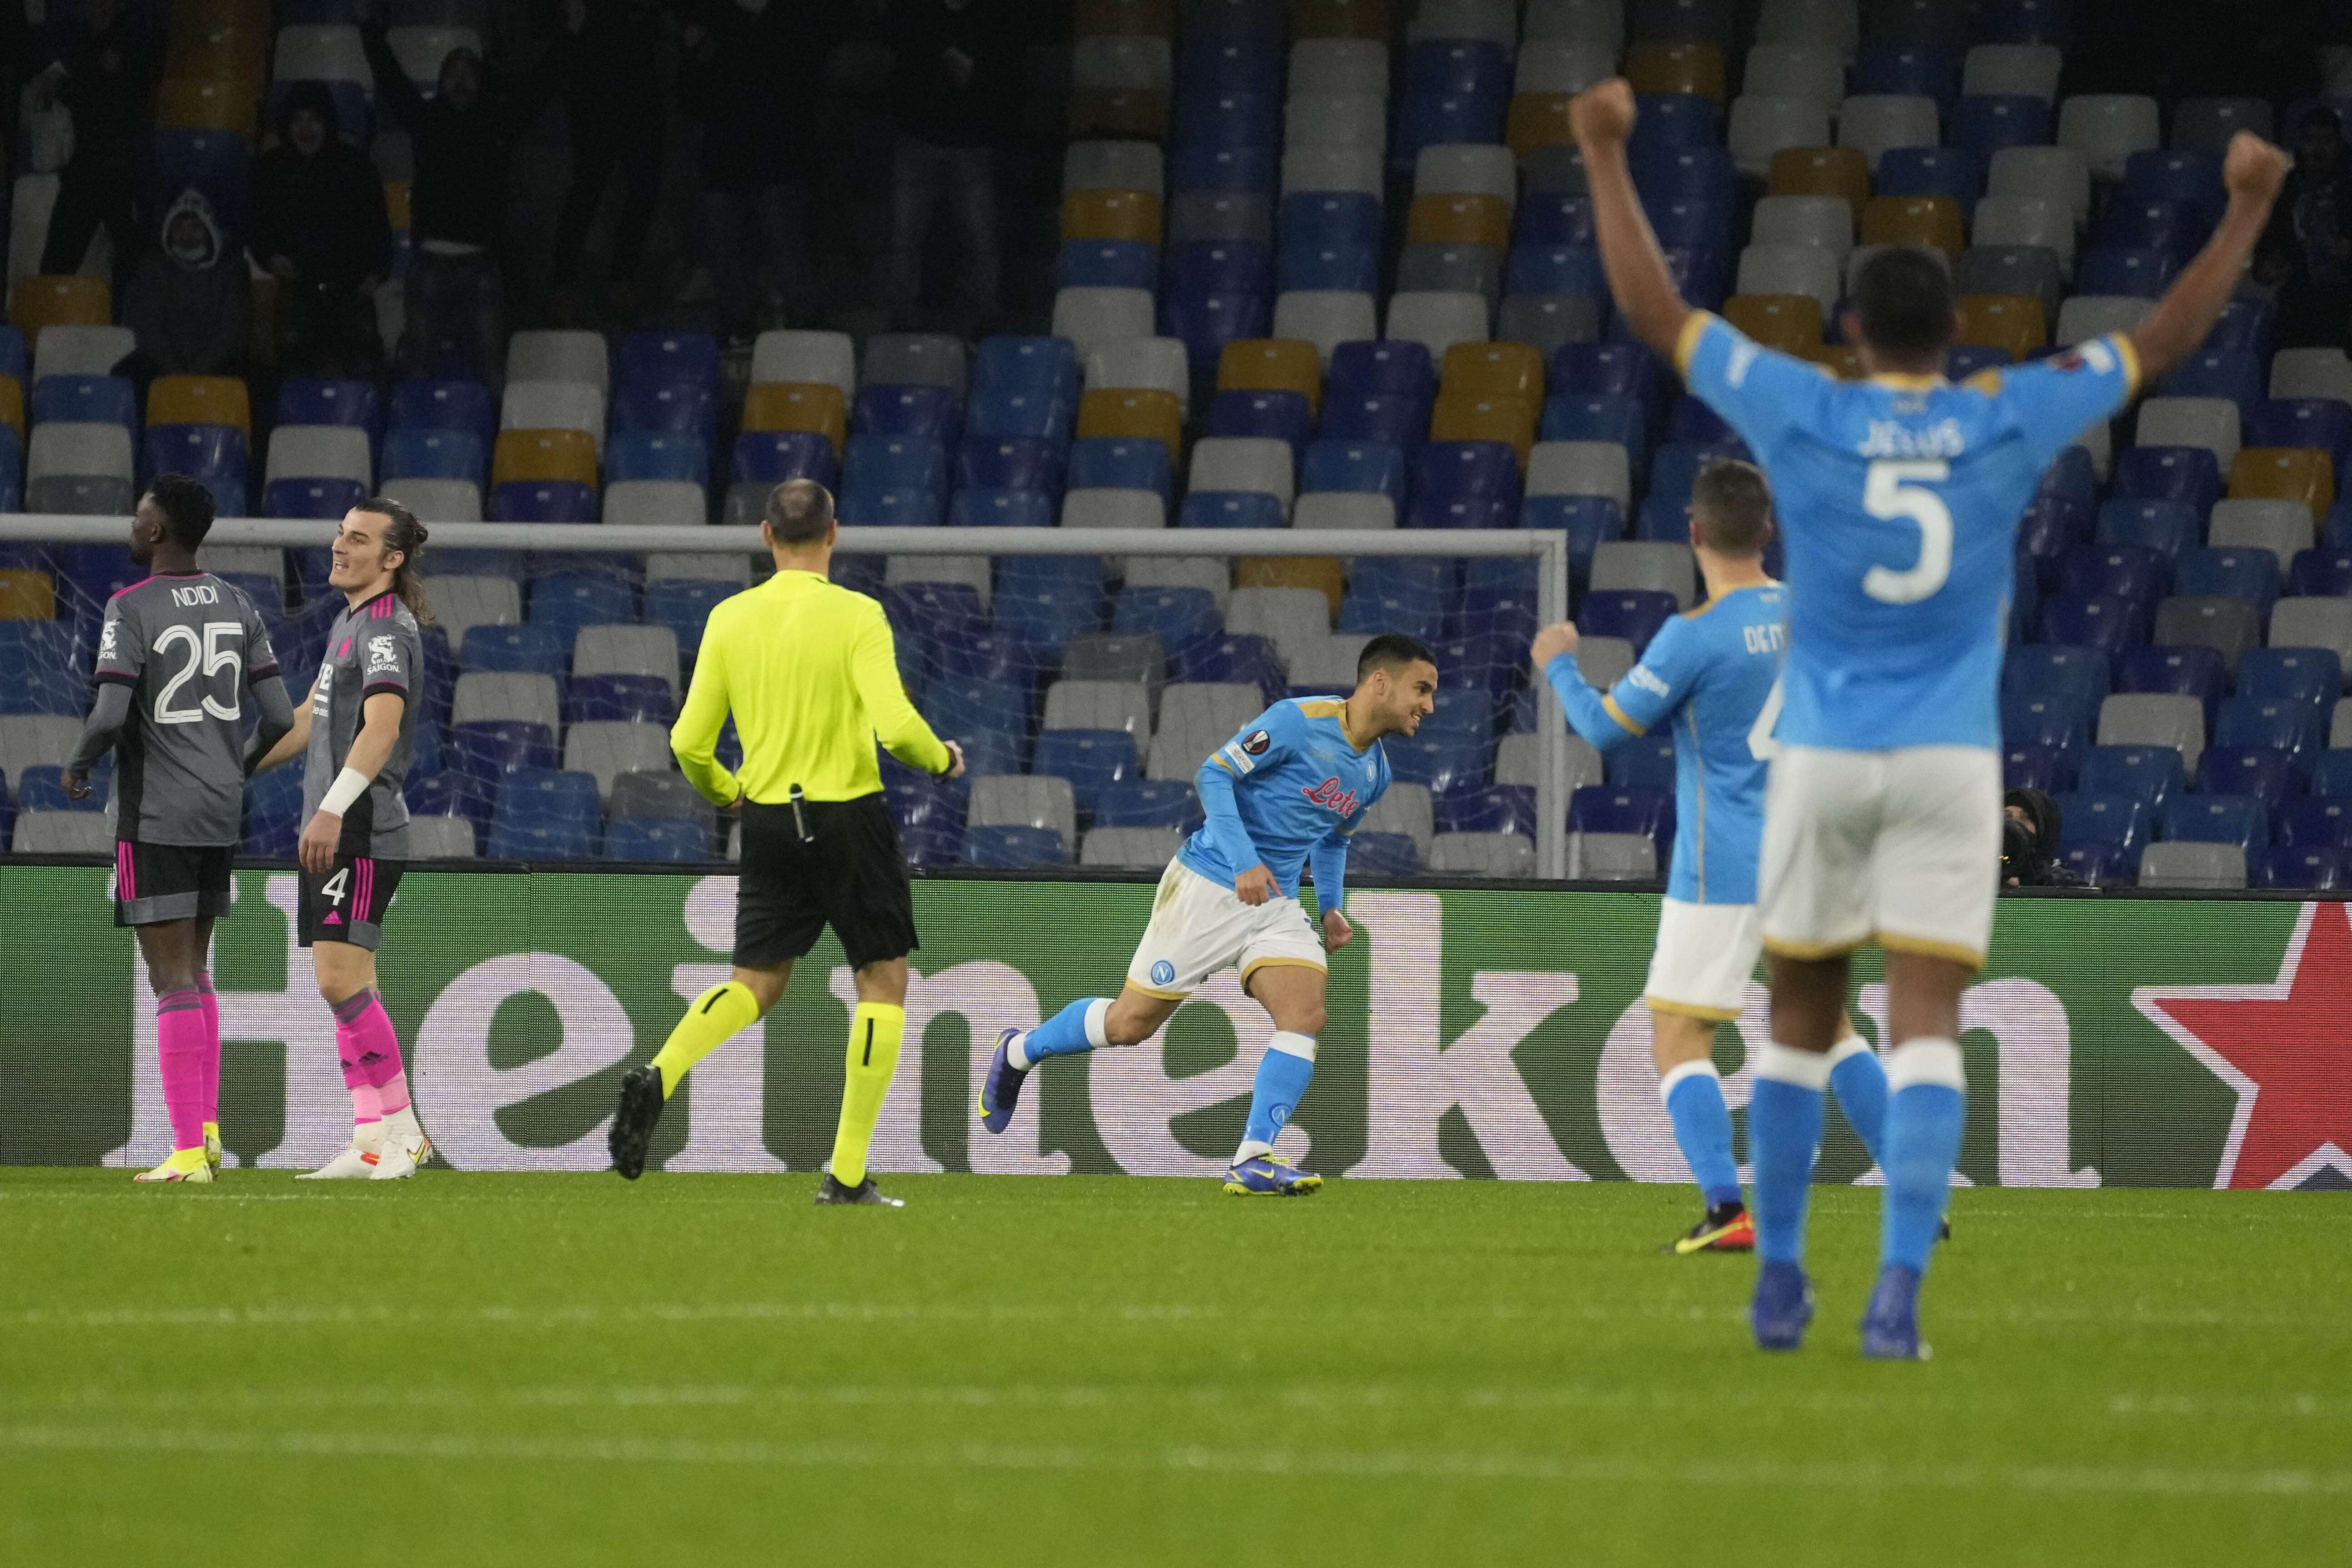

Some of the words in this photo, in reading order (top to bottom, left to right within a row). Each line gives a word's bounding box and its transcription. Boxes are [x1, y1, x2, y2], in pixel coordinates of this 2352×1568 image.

[1863, 459, 1954, 605] 5
[171, 585, 219, 608] NDIDI
[1743, 623, 1787, 654] DEM
[152, 622, 244, 724] 25
[1301, 776, 1359, 818] Lete
[321, 867, 349, 906] 4
[101, 873, 2102, 1187] Heineken
